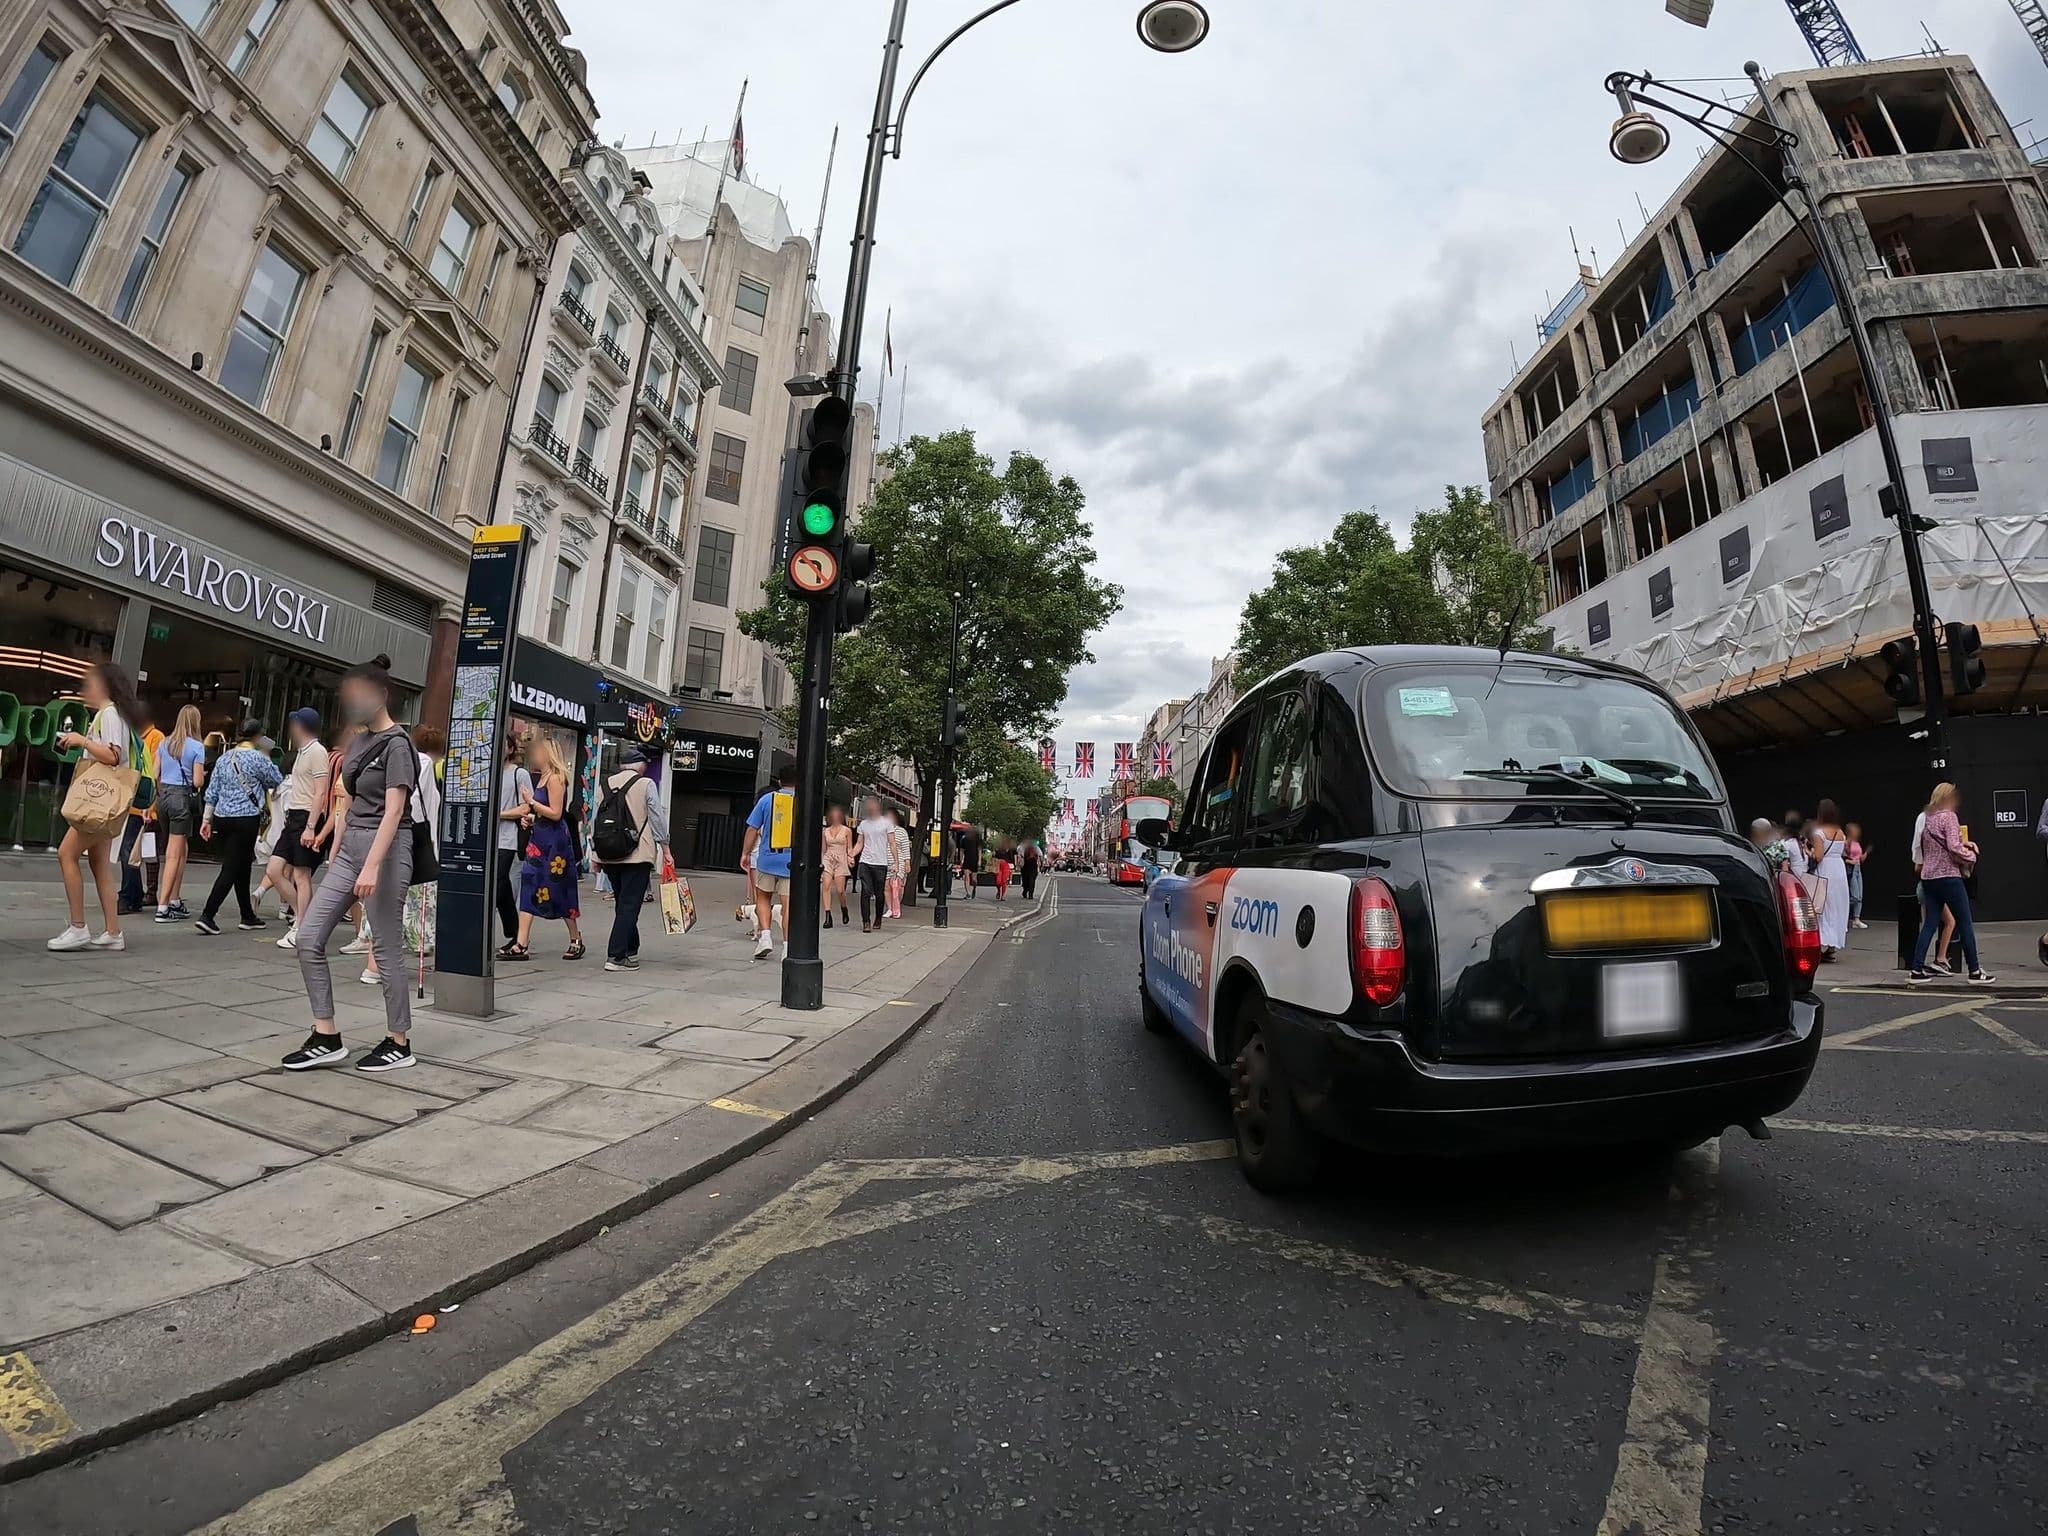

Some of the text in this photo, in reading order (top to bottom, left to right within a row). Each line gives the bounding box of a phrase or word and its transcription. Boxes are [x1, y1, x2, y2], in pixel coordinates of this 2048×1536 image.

[95, 517, 330, 643] SWAROVSKI
[707, 744, 754, 759] BELONG
[1996, 811, 2017, 823] RED
[1231, 896, 1279, 938] zoom
[1152, 921, 1203, 989] Zoom Phone
